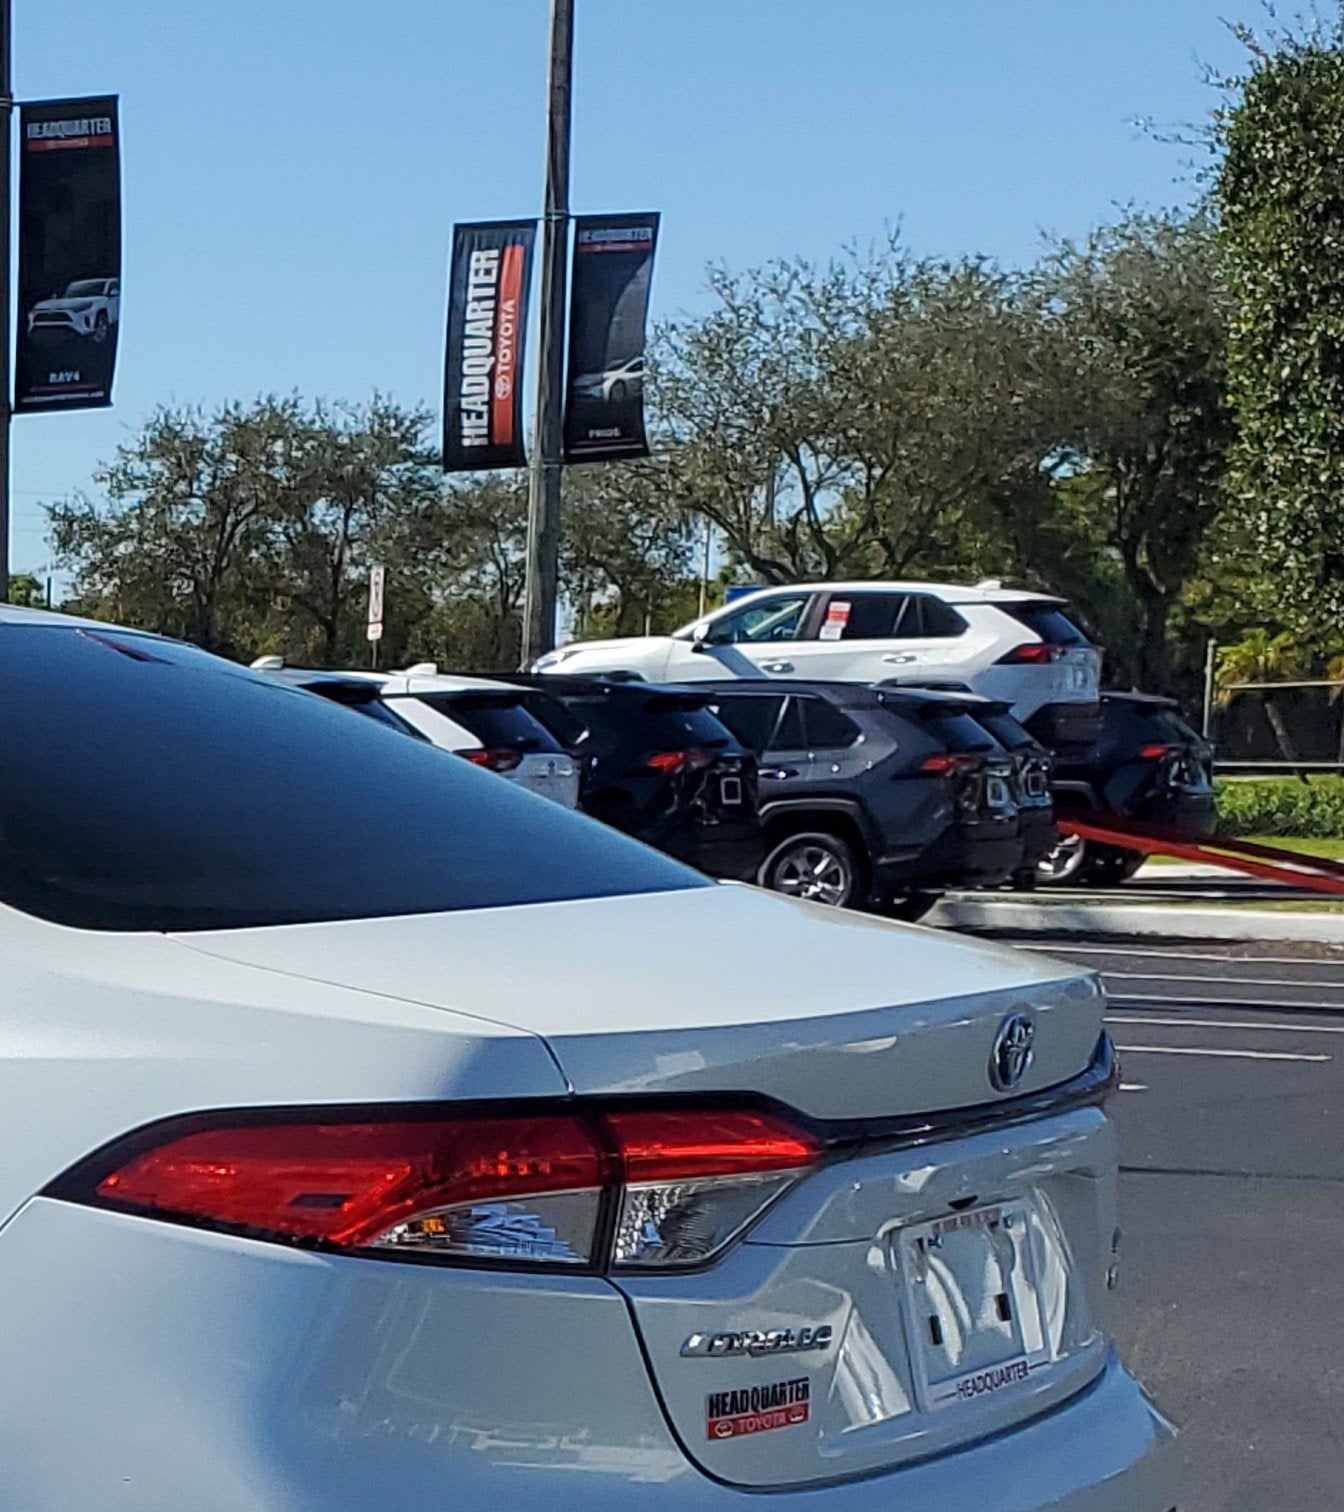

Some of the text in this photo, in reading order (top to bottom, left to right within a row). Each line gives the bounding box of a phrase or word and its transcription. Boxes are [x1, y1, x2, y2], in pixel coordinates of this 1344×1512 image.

[460, 248, 500, 447] HEADQUARTER
[496, 300, 516, 374] TOYOTA
[708, 1376, 810, 1419] HEADQUARTER
[956, 1360, 1030, 1399] HEADQUARTER
[738, 1413, 787, 1433] TOYOTA
